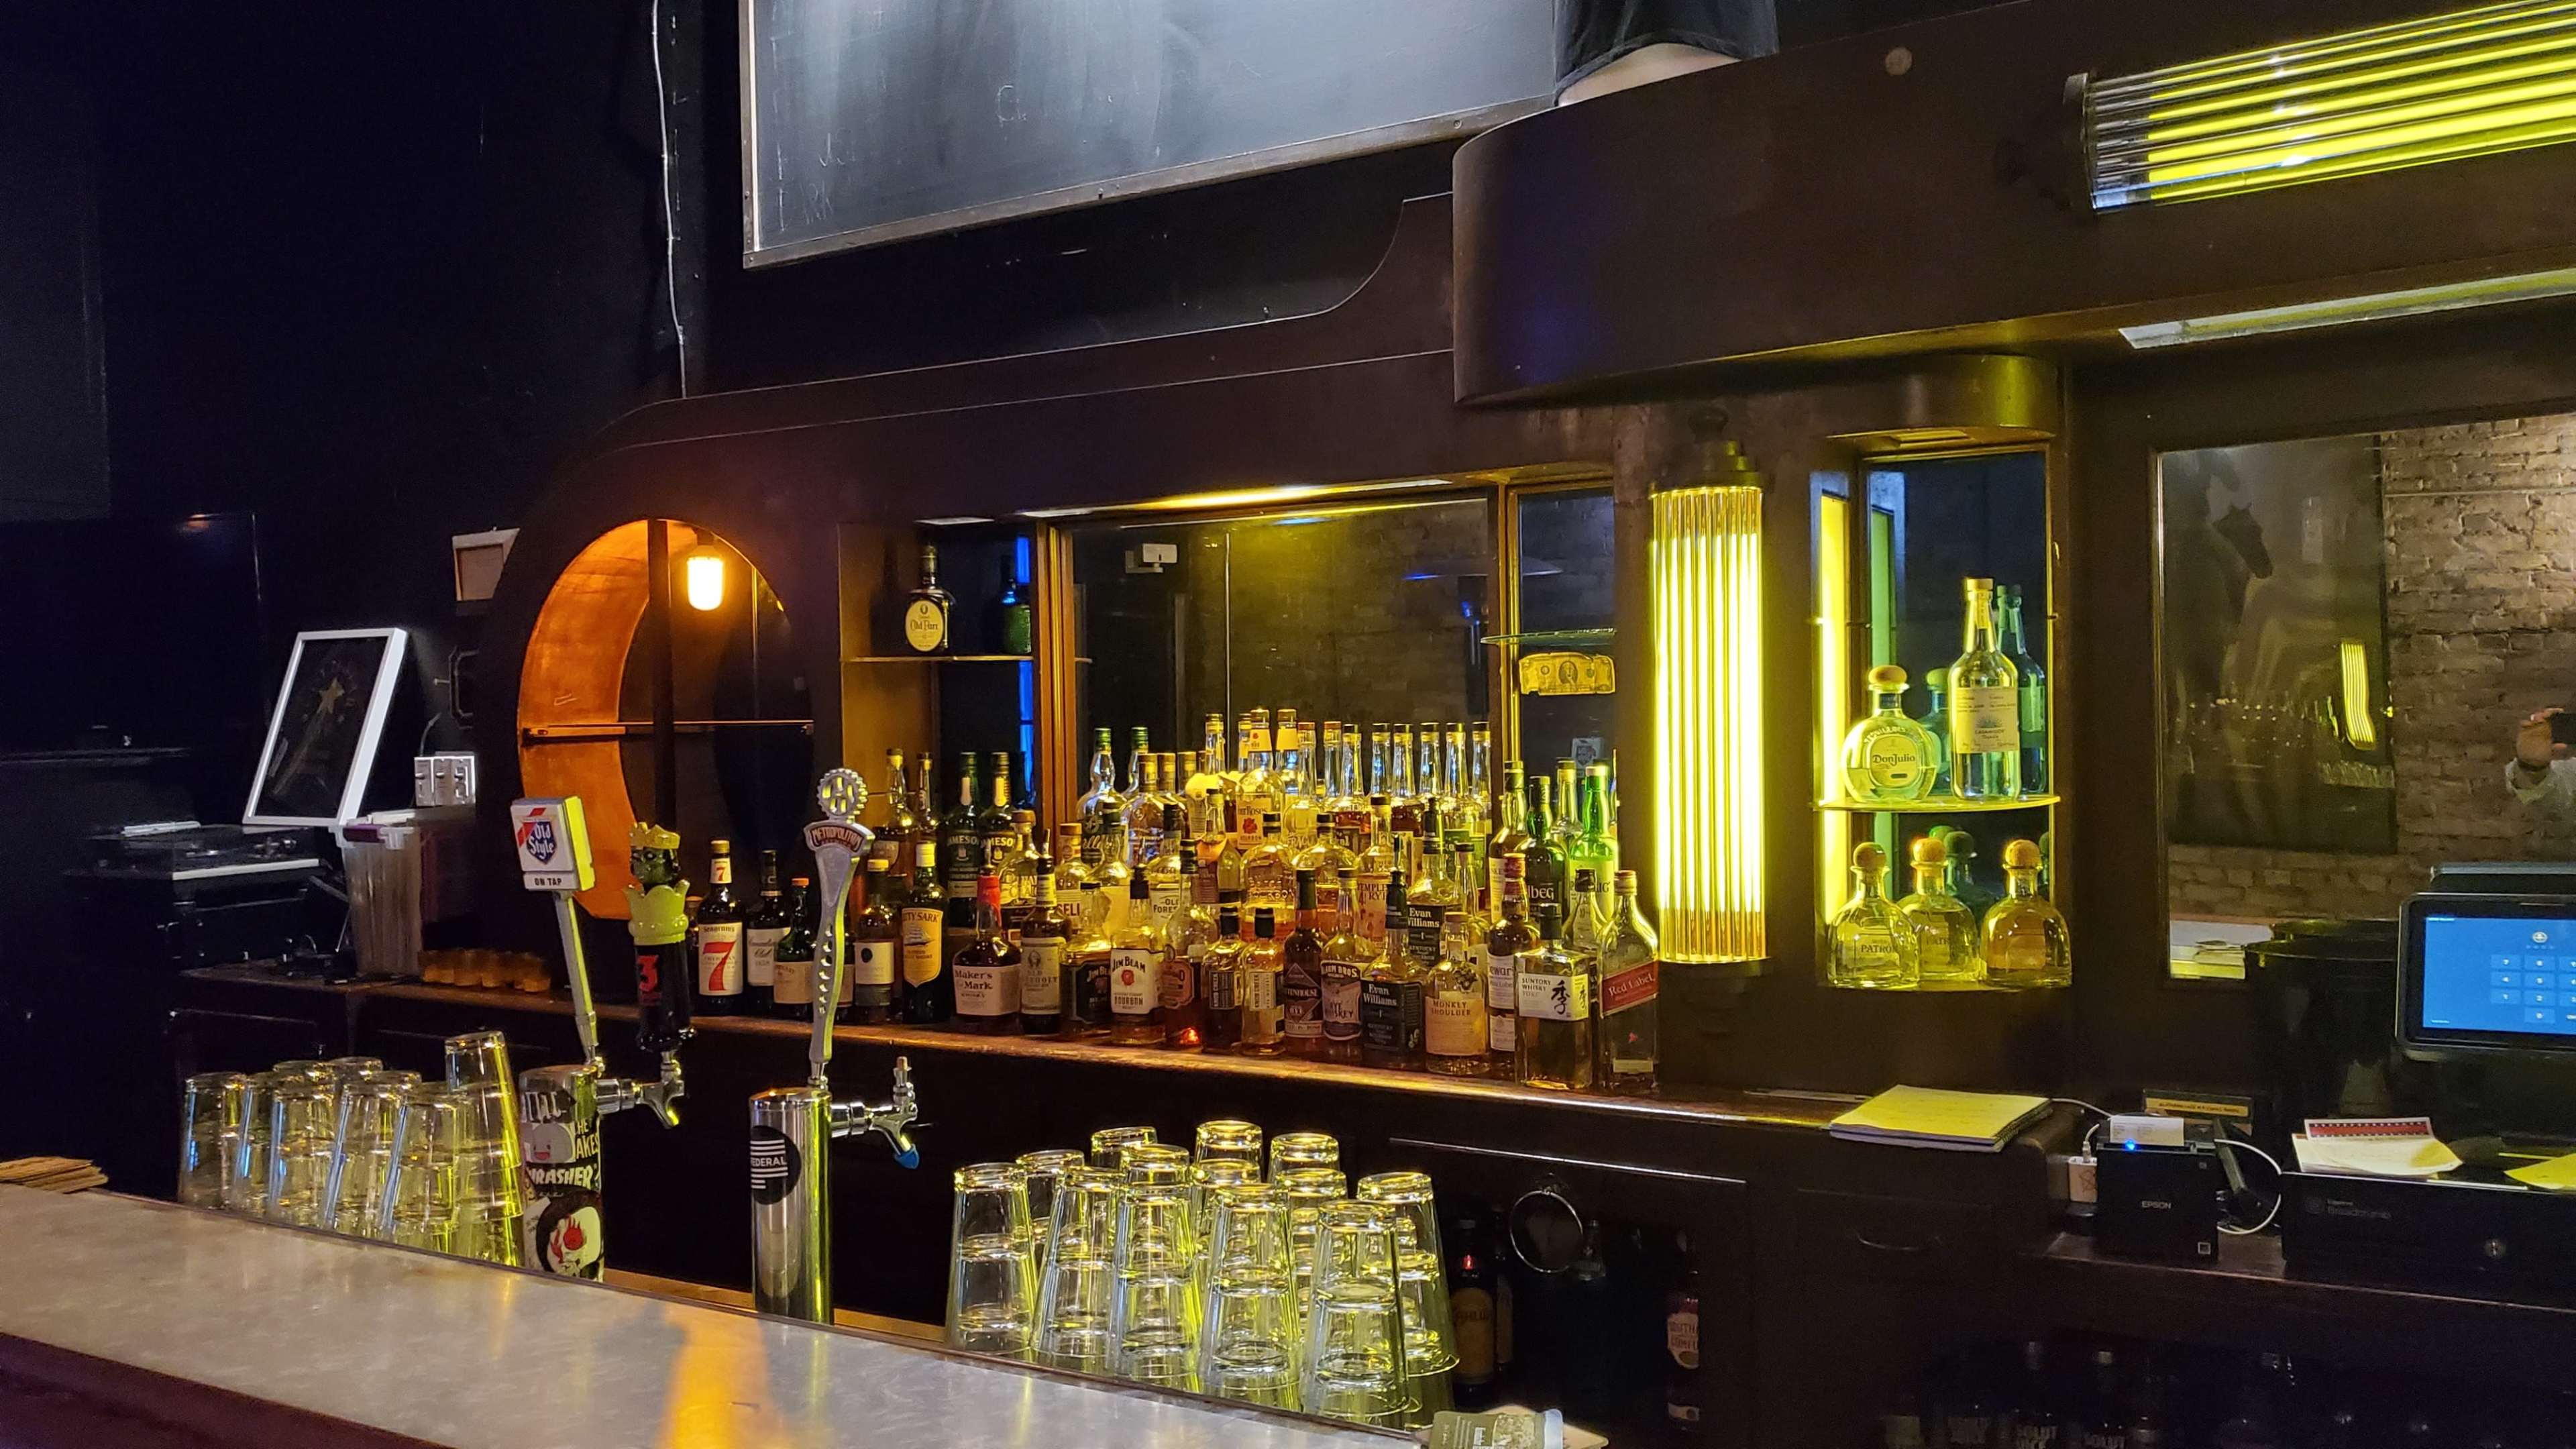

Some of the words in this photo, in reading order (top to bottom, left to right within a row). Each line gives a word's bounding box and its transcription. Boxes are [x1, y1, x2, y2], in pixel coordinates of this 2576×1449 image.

[534, 823, 551, 839] Old
[528, 835, 554, 859] Style
[716, 867, 725, 881] 7
[1409, 908, 1432, 918] Evan
[703, 941, 736, 991] 7
[1112, 959, 1124, 972] JIM
[1125, 956, 1146, 973] BEAM
[955, 970, 993, 979] Maker's
[1522, 977, 1551, 985] SUNTORY
[964, 980, 992, 989] Mark
[1368, 983, 1389, 996] Evan
[1609, 983, 1627, 996] Red
[1363, 993, 1397, 1006] Williams
[1433, 1000, 1467, 1008] MONKEY
[1432, 1008, 1471, 1016] SHOULDER
[751, 1157, 788, 1167] EDERAL
[526, 1164, 594, 1191] HRASHER
[2141, 1200, 2171, 1209] EPSON
